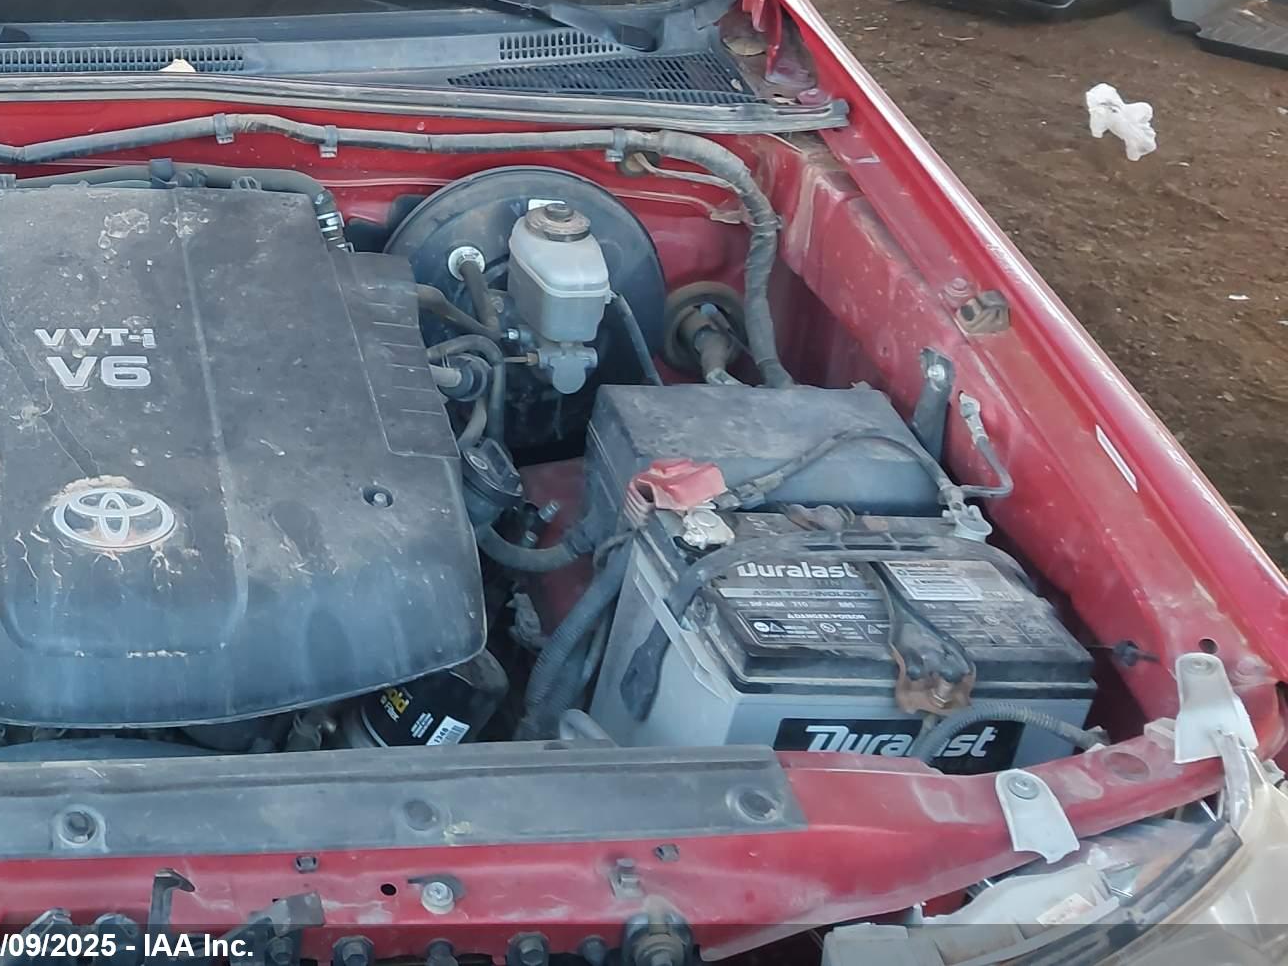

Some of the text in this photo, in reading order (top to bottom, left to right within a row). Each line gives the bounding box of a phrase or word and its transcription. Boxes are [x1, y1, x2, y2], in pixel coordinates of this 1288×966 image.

[45, 355, 152, 387] V6
[736, 561, 859, 578] Duralast
[787, 590, 870, 598] TECHNOLOGY
[804, 724, 998, 758] Durast
